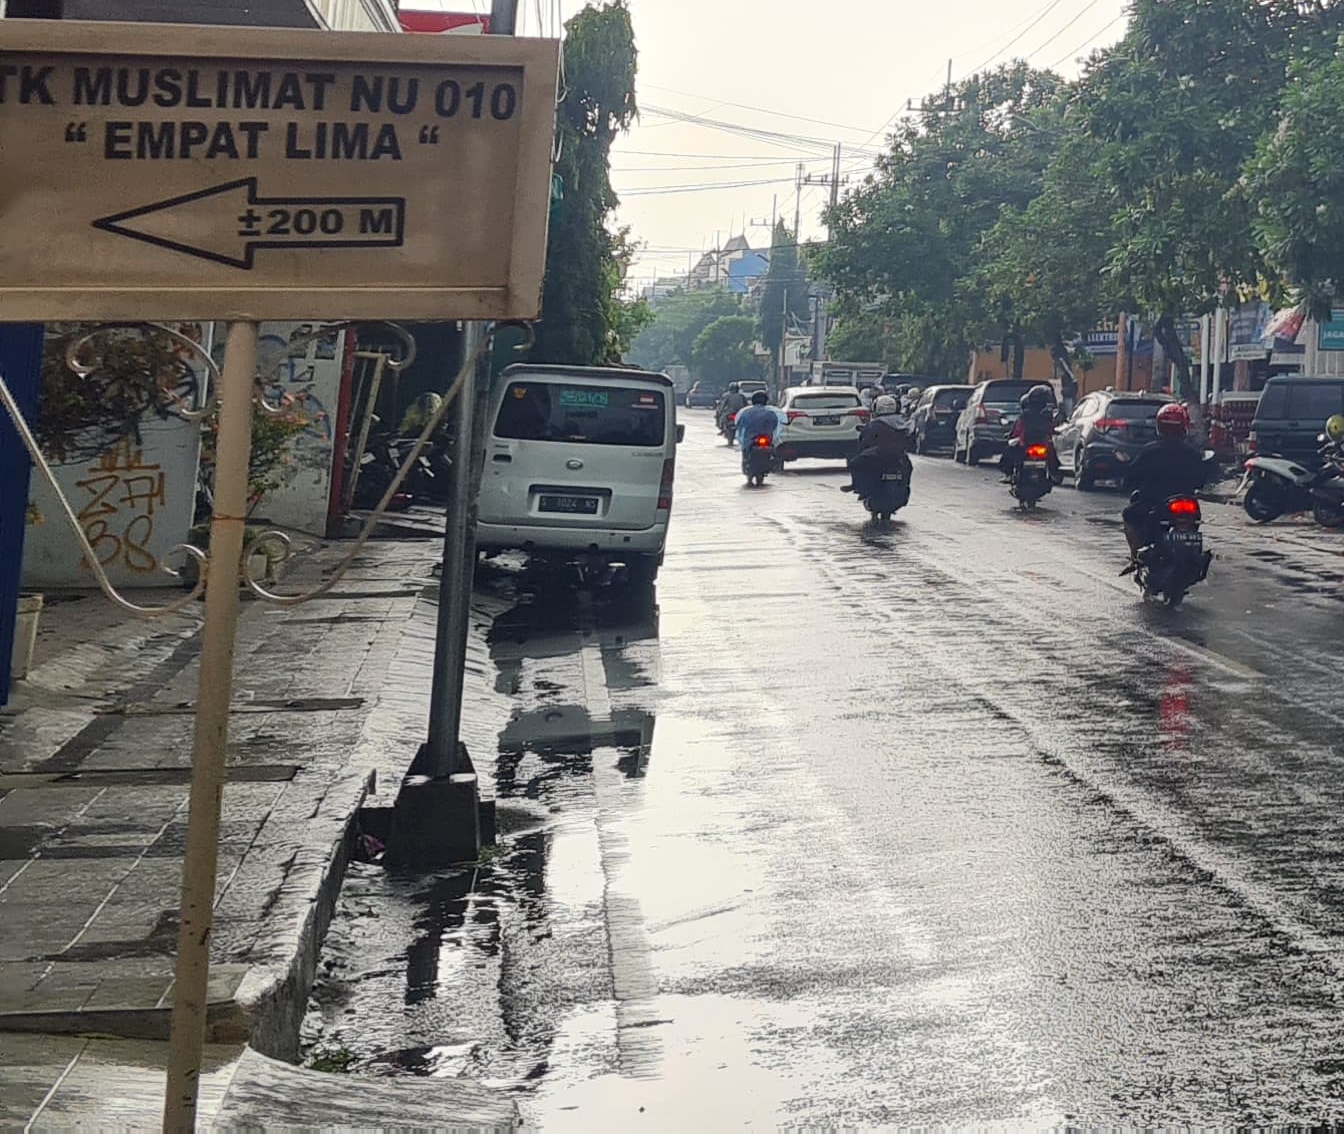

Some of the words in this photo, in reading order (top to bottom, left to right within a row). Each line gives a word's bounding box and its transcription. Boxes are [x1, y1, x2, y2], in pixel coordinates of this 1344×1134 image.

[73, 67, 336, 111] MUSLIMAT
[351, 75, 419, 114] NU
[434, 79, 516, 120] 010
[104, 121, 269, 160] EMPAT
[285, 122, 402, 160] LIMA
[358, 208, 394, 235] M
